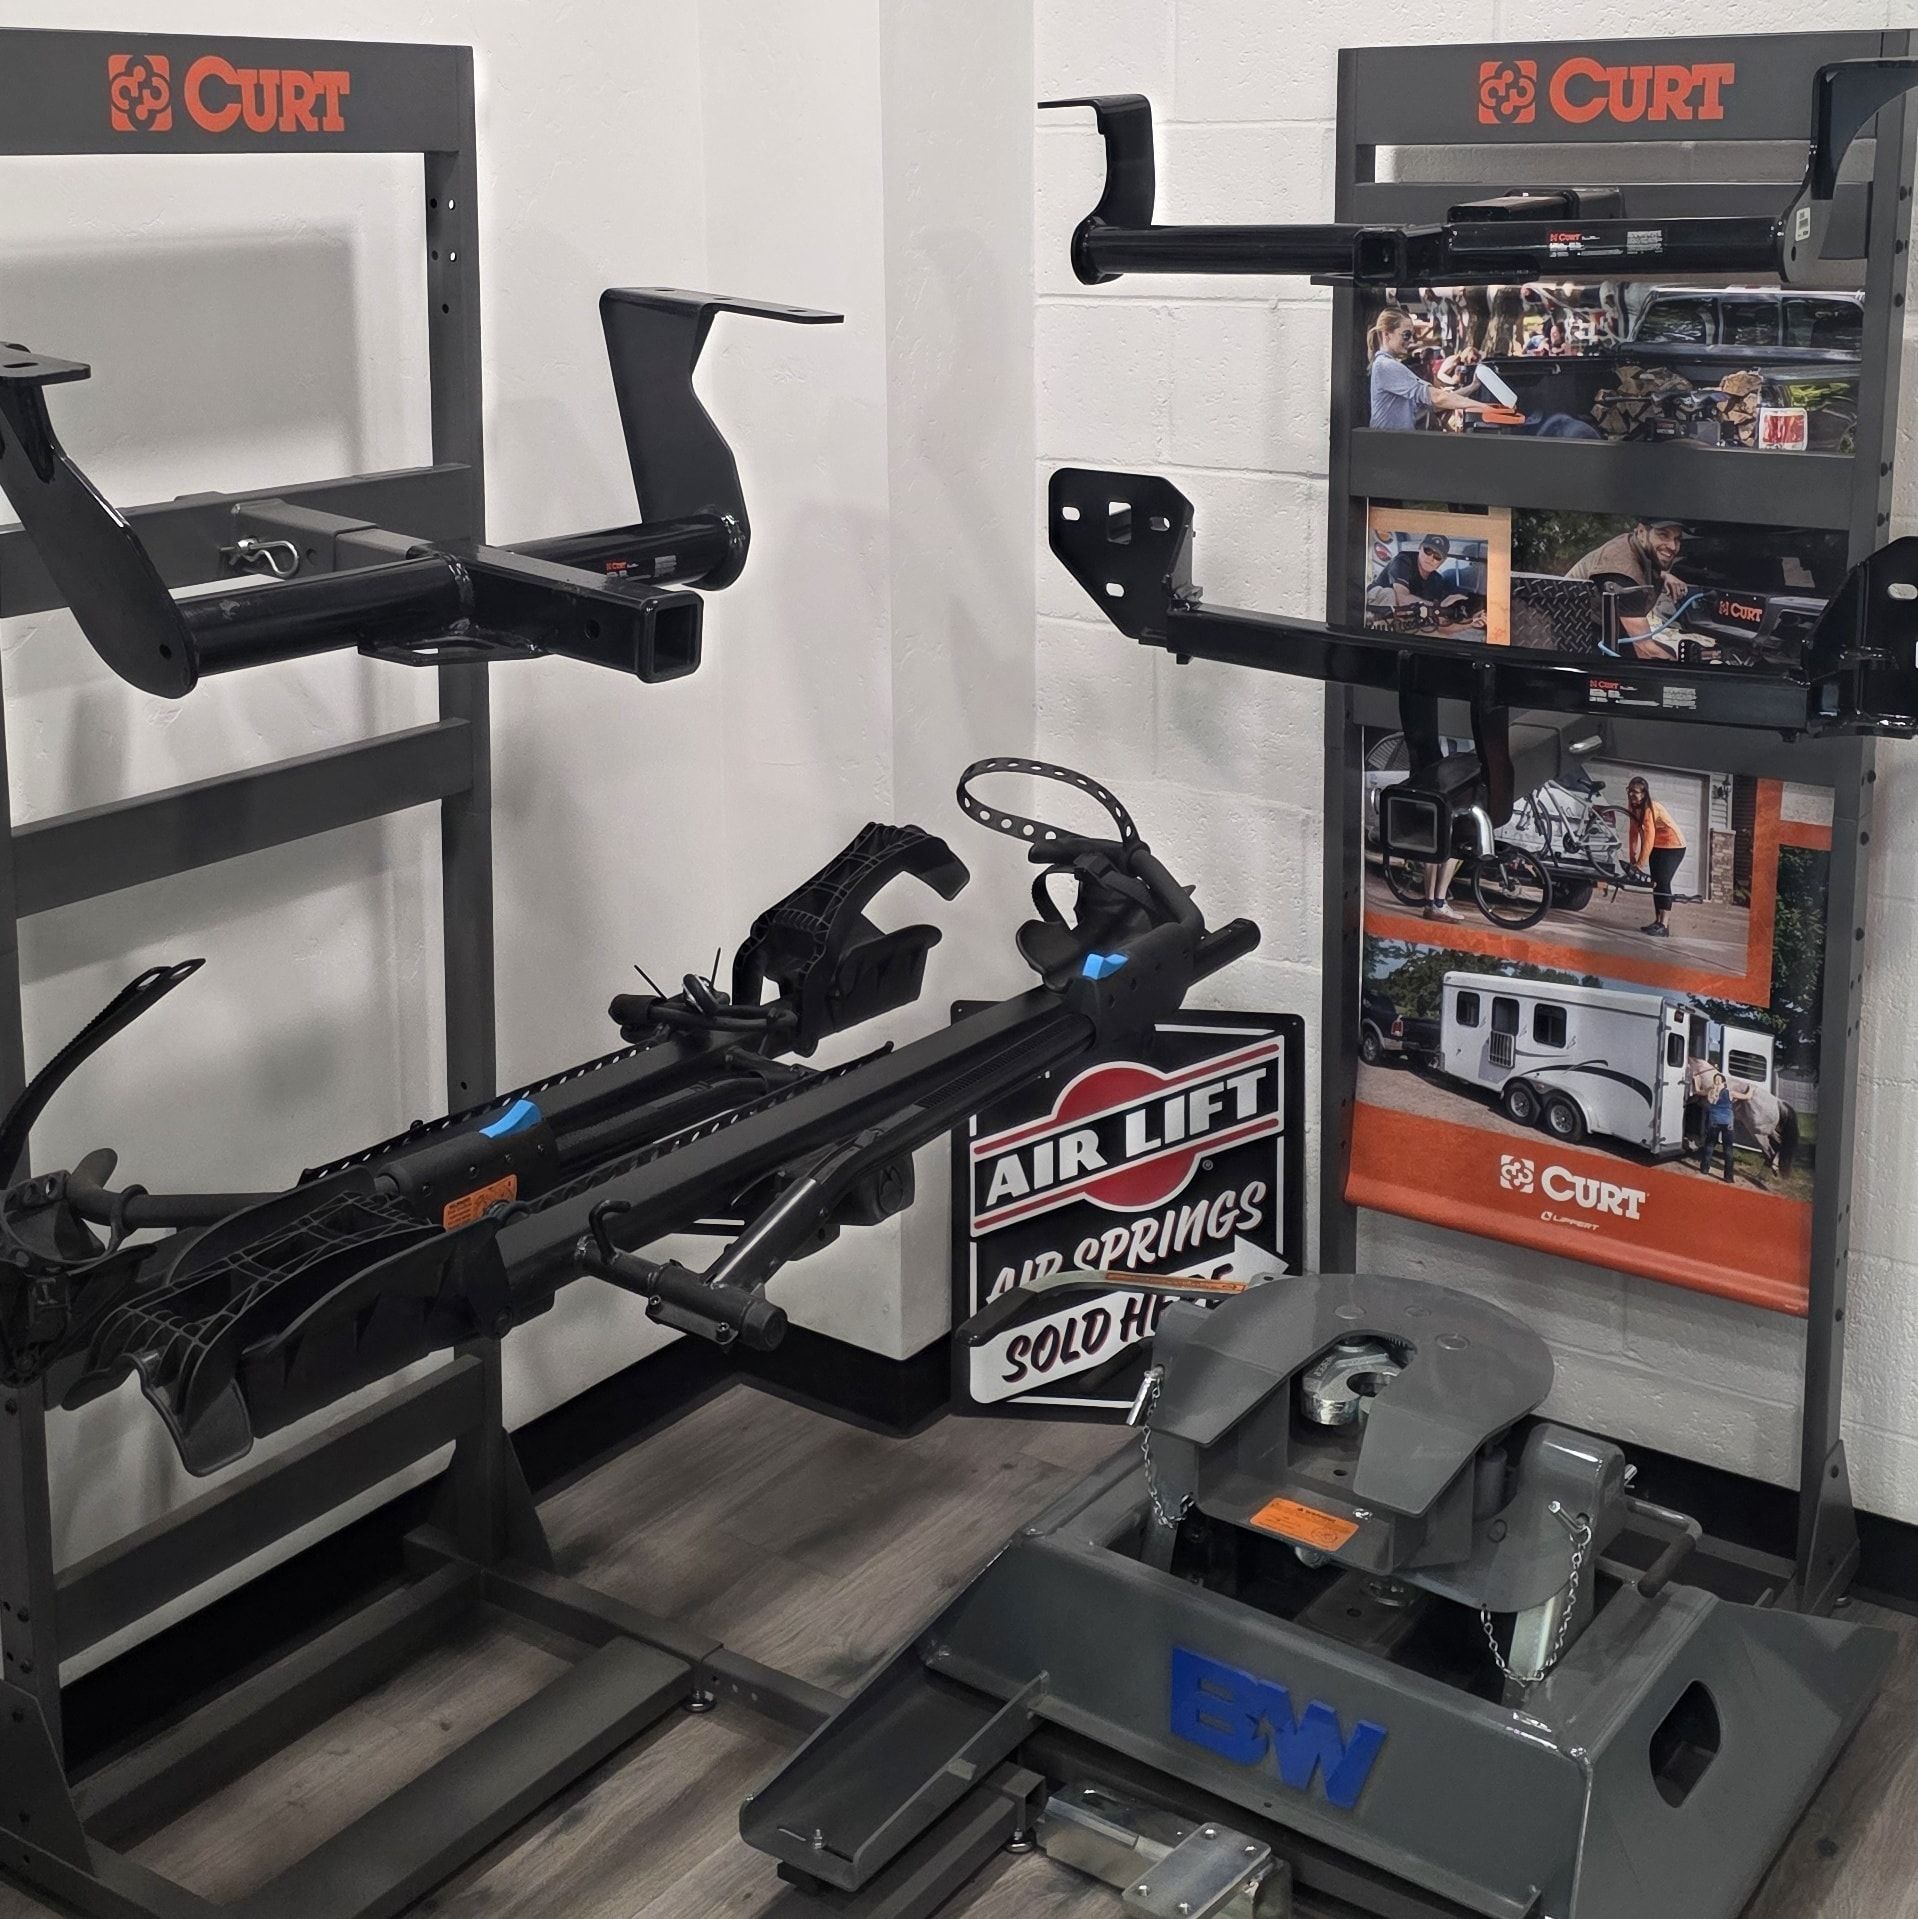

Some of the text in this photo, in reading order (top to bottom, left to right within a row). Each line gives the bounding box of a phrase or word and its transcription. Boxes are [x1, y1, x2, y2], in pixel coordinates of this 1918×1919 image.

[184, 55, 351, 133] CURT
[1549, 57, 1736, 124] CURT
[1731, 603, 1762, 621] CURT
[986, 1067, 1267, 1207] AIR LIFT
[1073, 1180, 1267, 1273] SPRINGS
[1541, 1165, 1645, 1220] CURT
[1552, 1214, 1600, 1231] LIPPERT
[1002, 1308, 1113, 1384] SOLD
